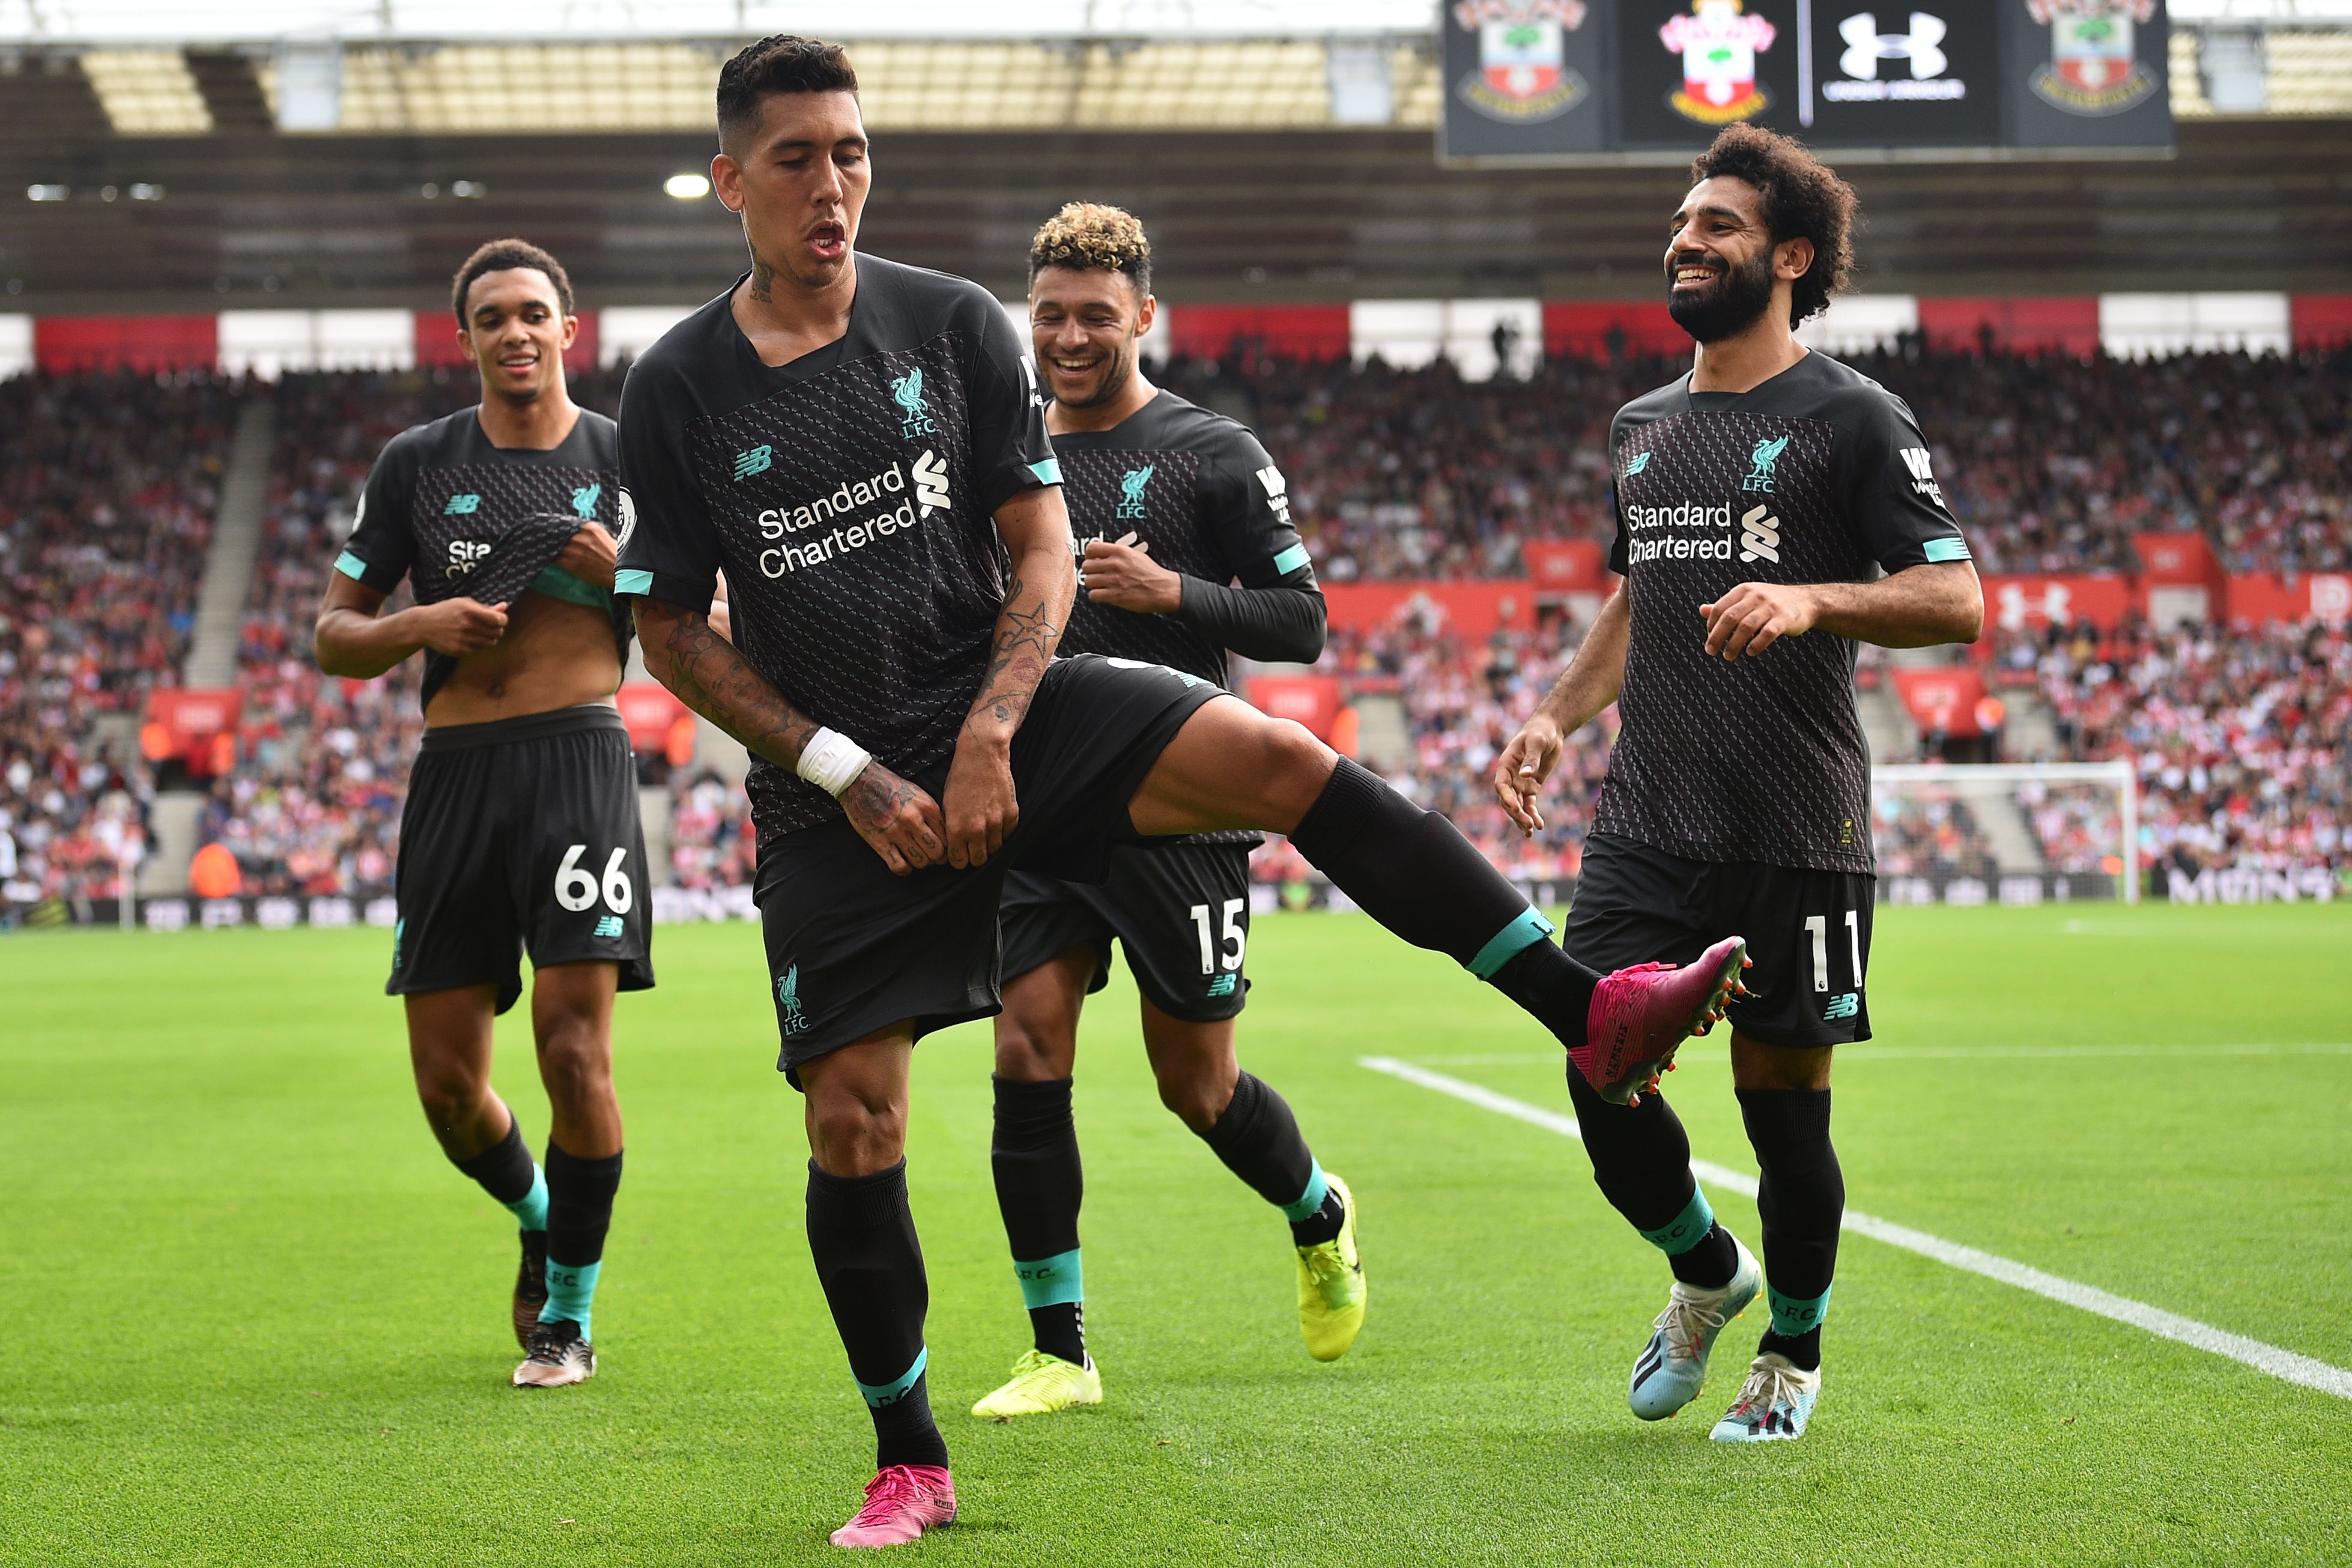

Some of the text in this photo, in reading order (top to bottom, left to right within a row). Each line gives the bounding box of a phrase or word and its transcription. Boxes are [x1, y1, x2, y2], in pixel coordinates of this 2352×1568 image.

[758, 461, 905, 539] Standard
[759, 497, 917, 579] Chartered
[1628, 500, 1731, 531] Standard
[1628, 533, 1732, 565] Chartered
[554, 844, 632, 915] 66
[1190, 898, 1246, 975] 15
[1804, 910, 1863, 993] 11
